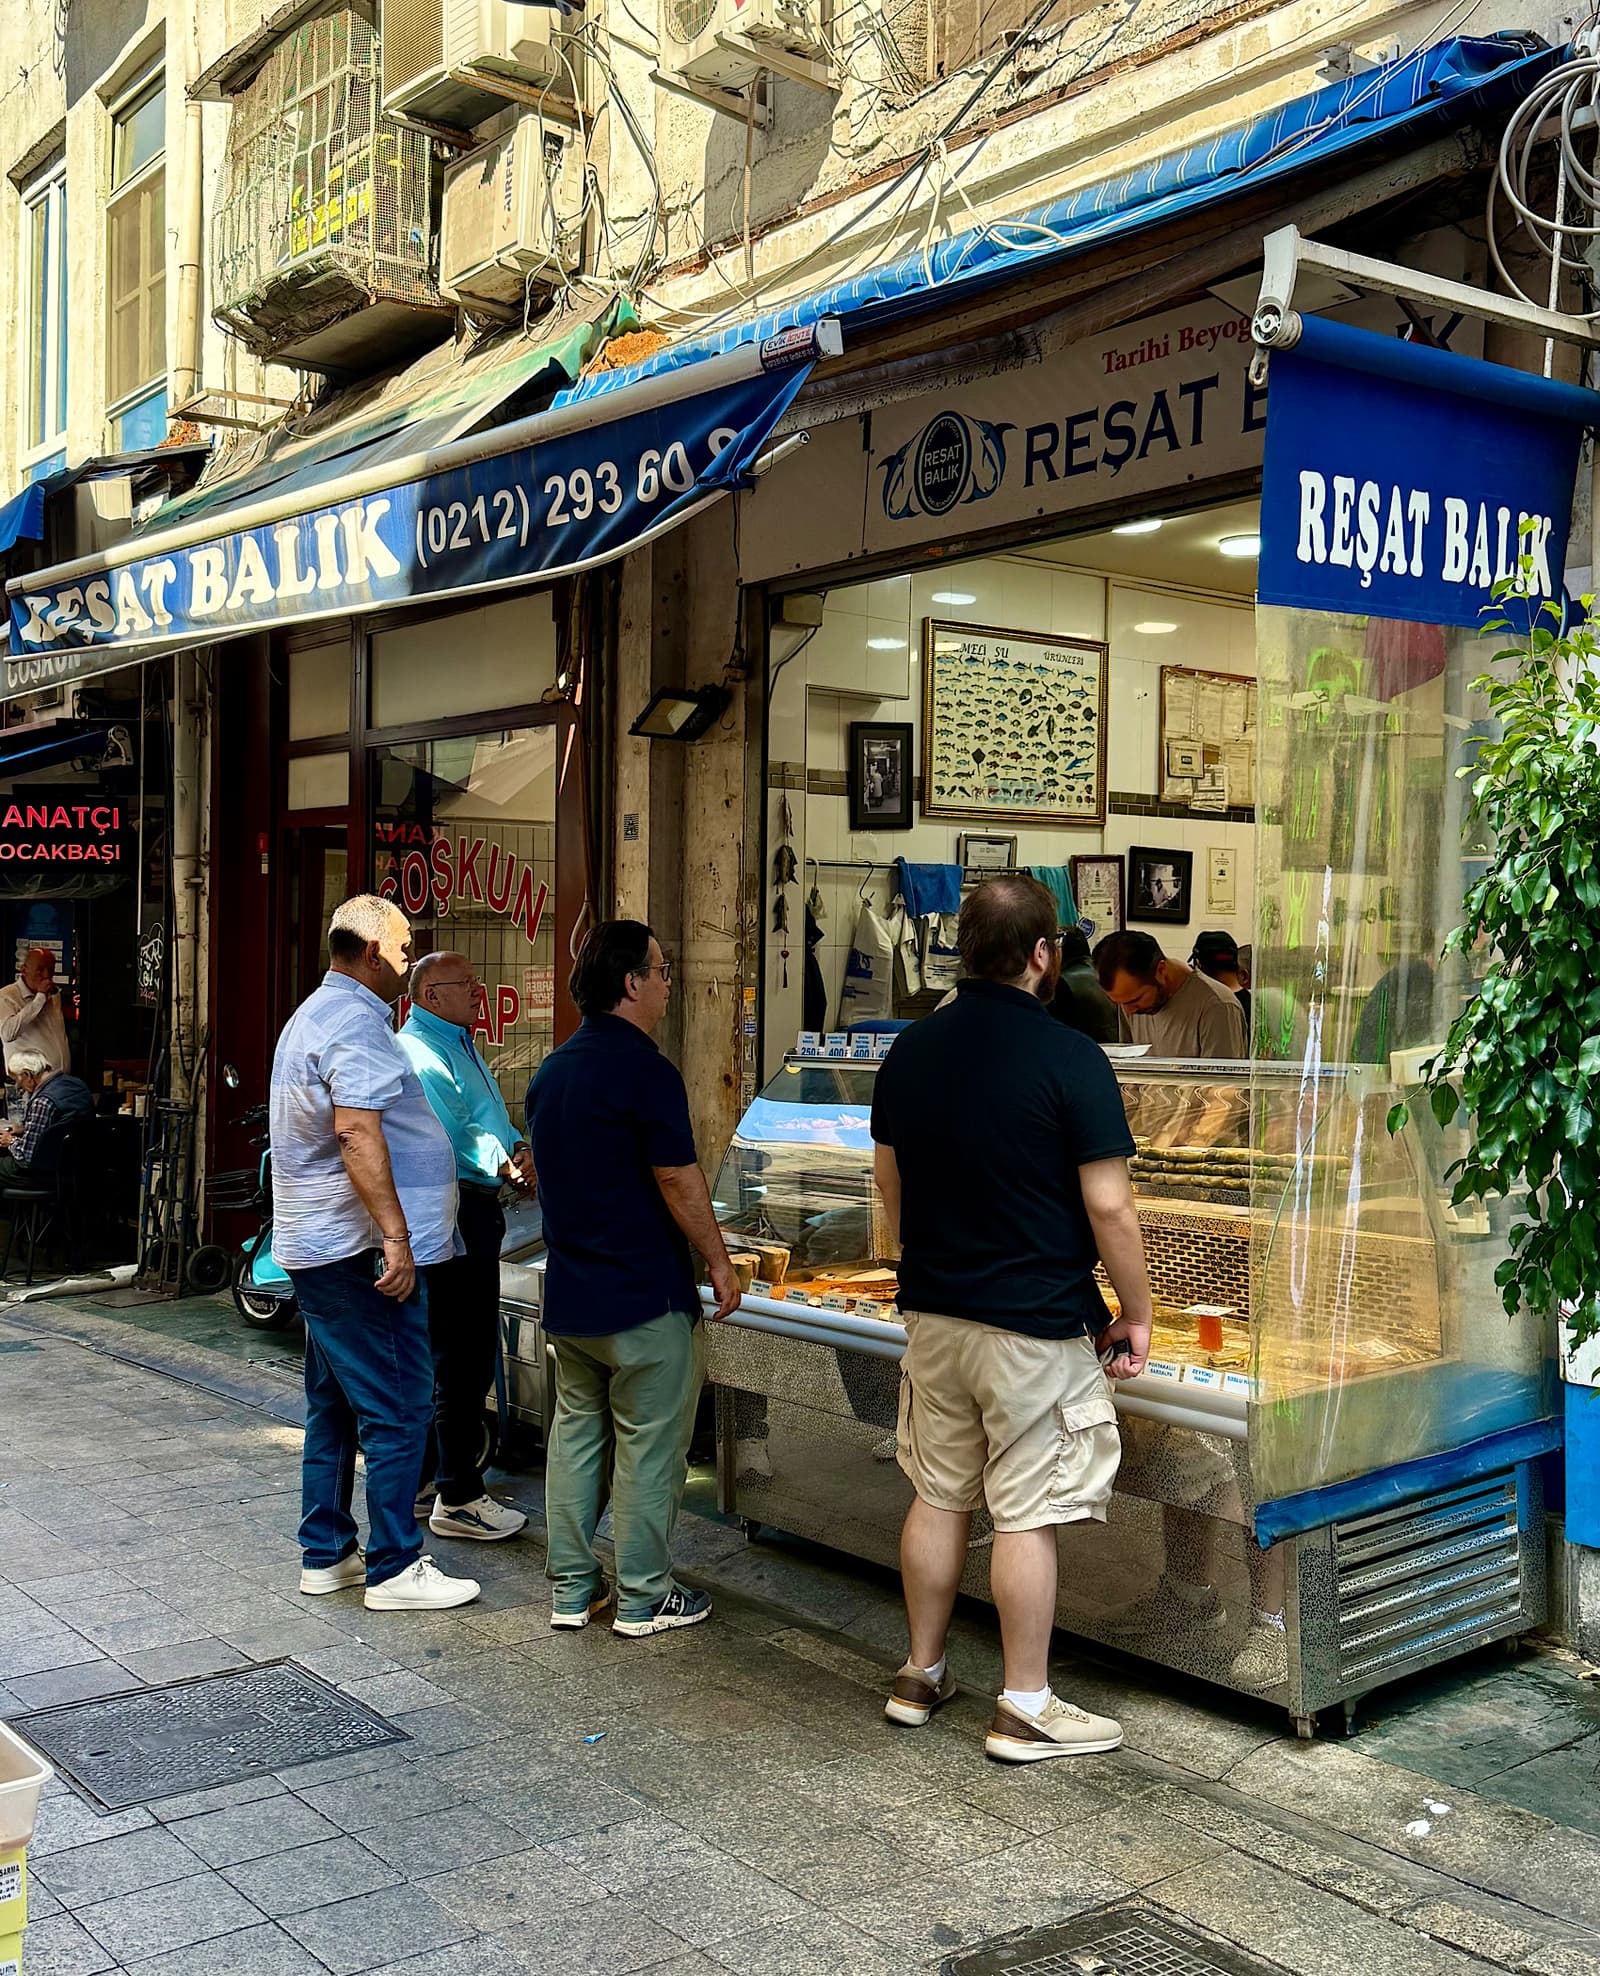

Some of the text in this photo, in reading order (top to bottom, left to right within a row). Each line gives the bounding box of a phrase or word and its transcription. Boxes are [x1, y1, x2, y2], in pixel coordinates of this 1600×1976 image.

[1102, 334, 1170, 375] Tarihi
[1023, 372, 1220, 488] REŞAT
[924, 443, 962, 468] REŞAT
[924, 463, 960, 486] BALIK
[20, 440, 696, 645] REŞAT BALIK (0212) 293 60
[1296, 470, 1552, 598] REŞAT BALIK
[994, 646, 1009, 659] SU
[1, 804, 120, 836] ANATÇI
[0, 843, 121, 865] OCAKBAŞI
